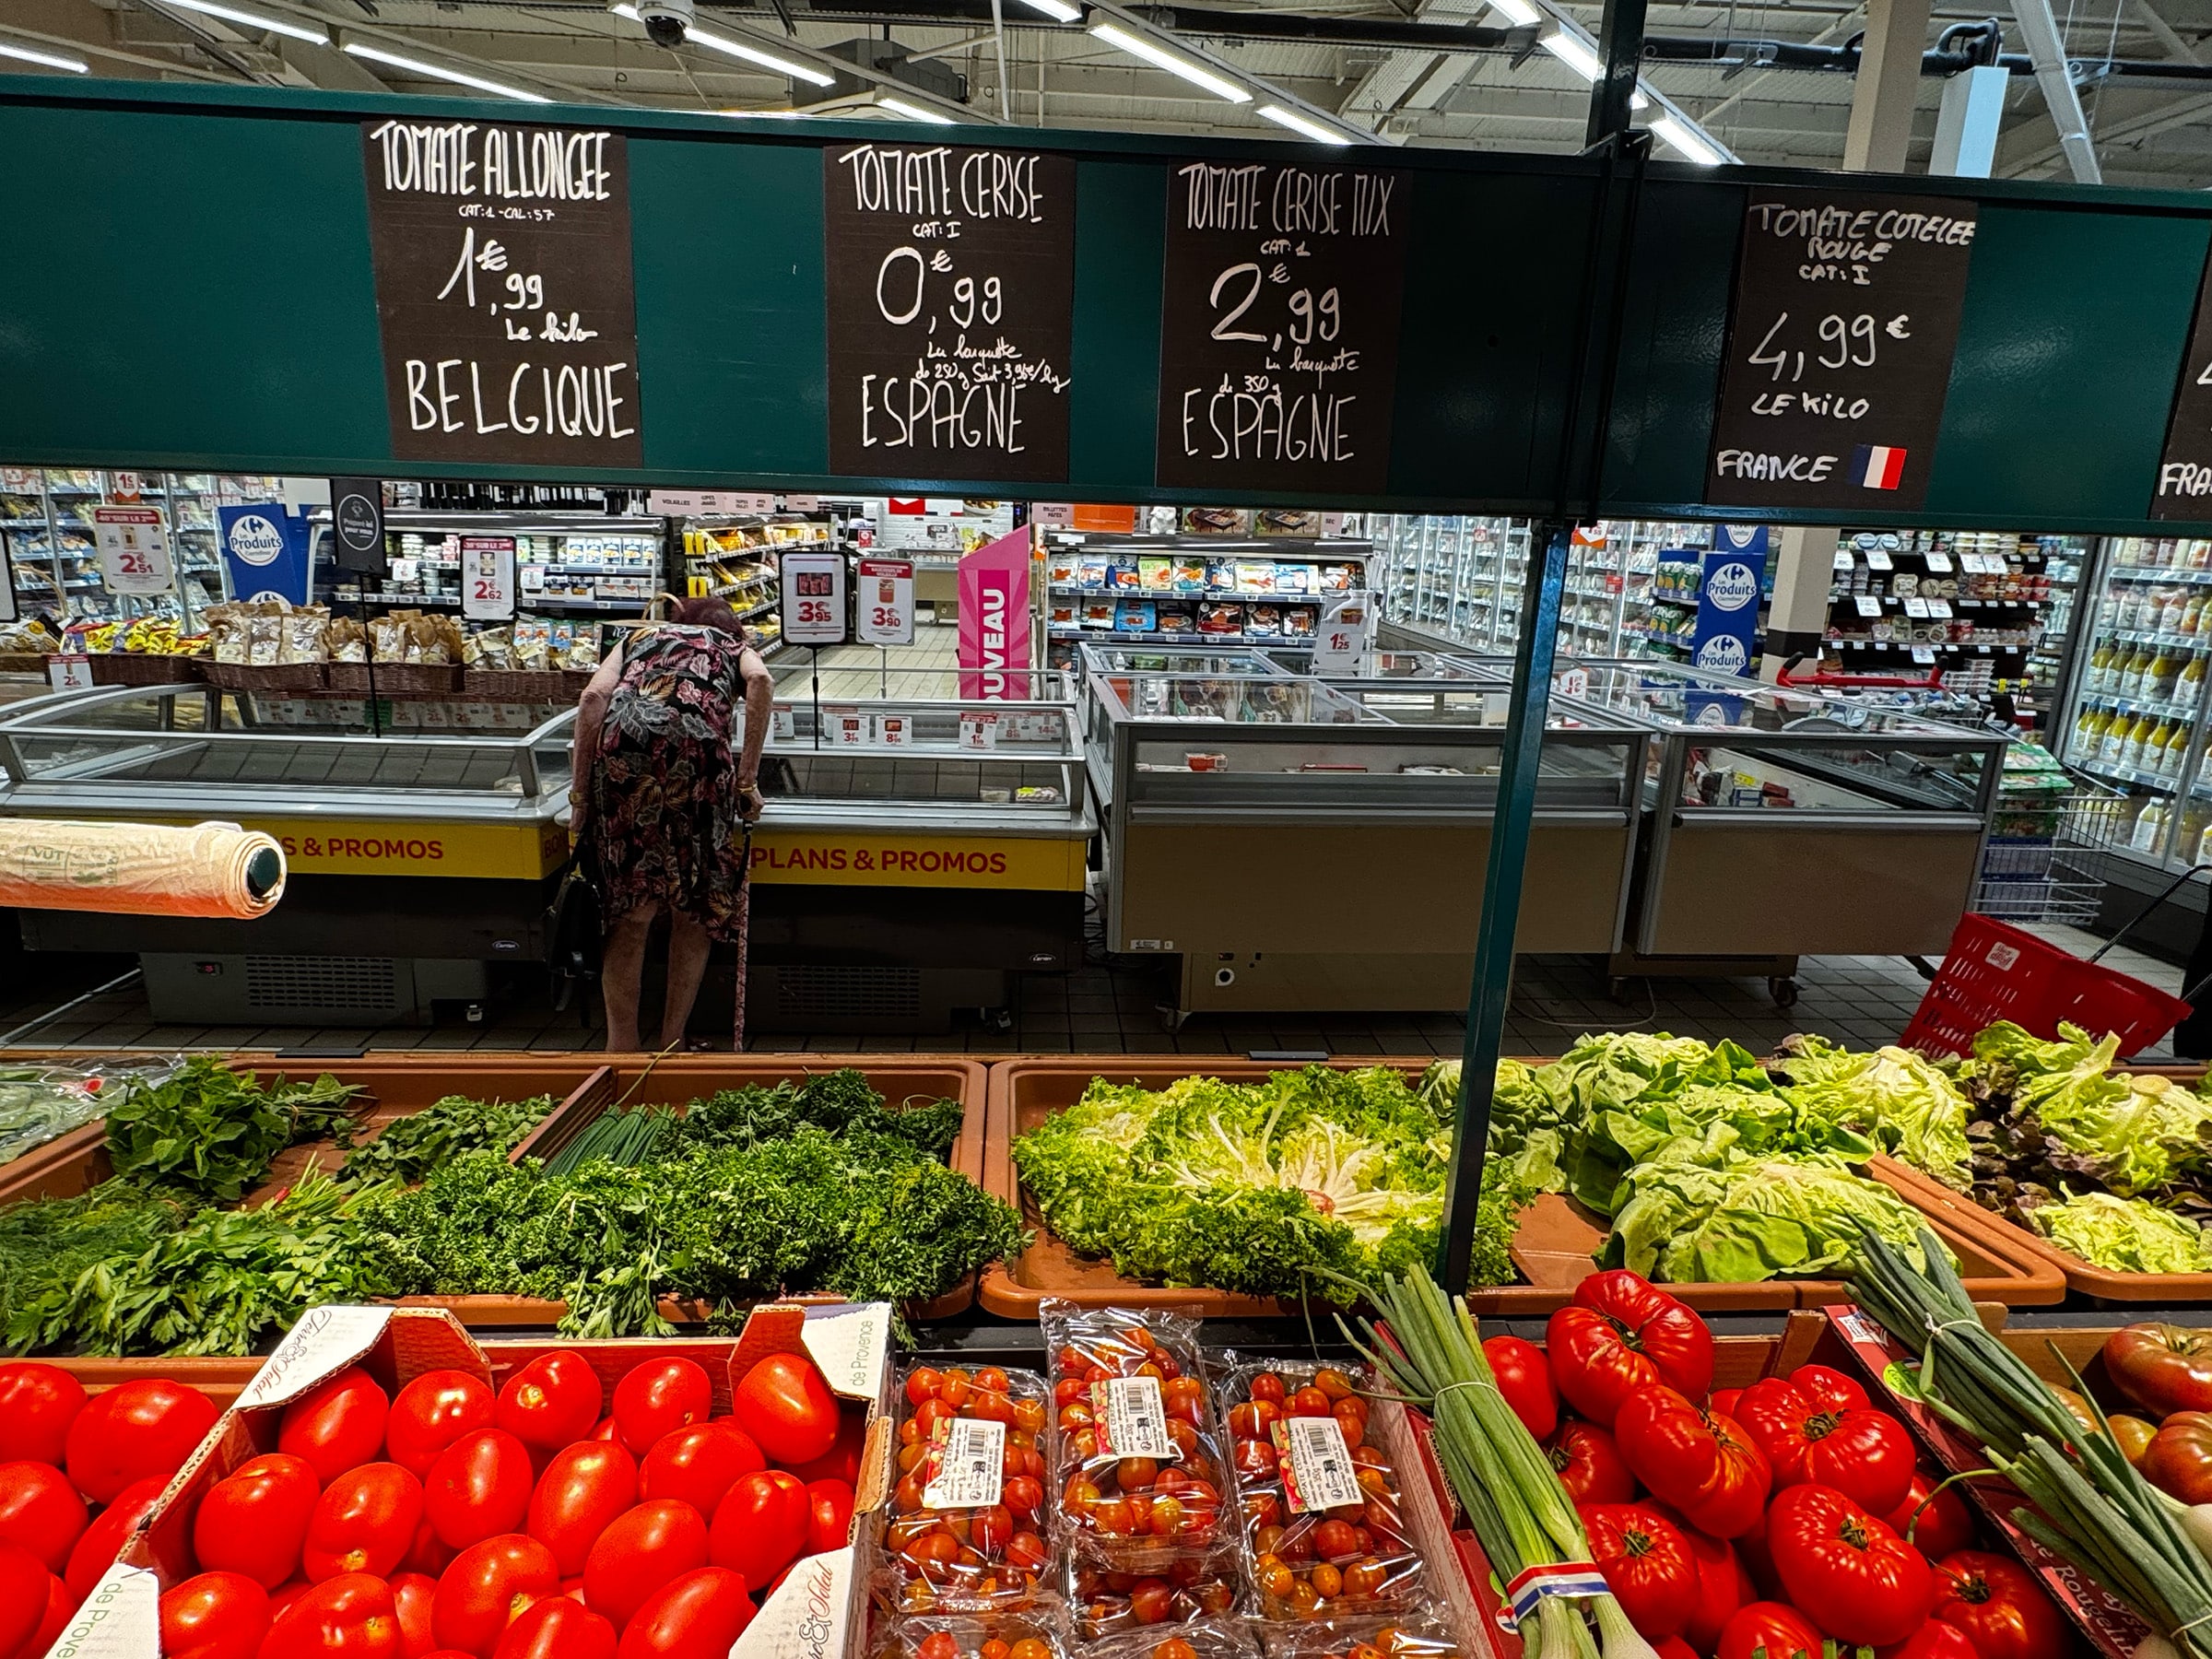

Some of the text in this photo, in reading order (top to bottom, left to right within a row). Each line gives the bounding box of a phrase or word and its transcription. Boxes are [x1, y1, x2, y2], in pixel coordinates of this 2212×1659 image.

[371, 121, 610, 200] TOMATE ALLONGEE
[839, 145, 1043, 223] TOMATE CERISE
[1179, 162, 1394, 237] TOMATE CERISE MIX
[1749, 203, 1976, 246] TOMATE COTELEE
[1808, 236, 1892, 263] ROUGE
[406, 359, 635, 439] BELGIQUE
[862, 374, 1026, 453] ESPAGNE
[1751, 393, 1797, 416] LE
[1183, 388, 1357, 462] ESPAGNE
[1716, 449, 1839, 483] FRANCE
[230, 535, 282, 550] Produits
[1708, 582, 1756, 595] Produits
[982, 588, 1006, 700] UVEAU
[1698, 653, 1747, 666] Produits
[303, 837, 323, 857] &
[327, 838, 444, 860] PROMOS
[750, 847, 848, 871] PLANS
[853, 849, 876, 872] &
[881, 850, 1007, 875] PROMOS
[850, 1320, 874, 1387] de Provence
[95, 1583, 124, 1605] de
